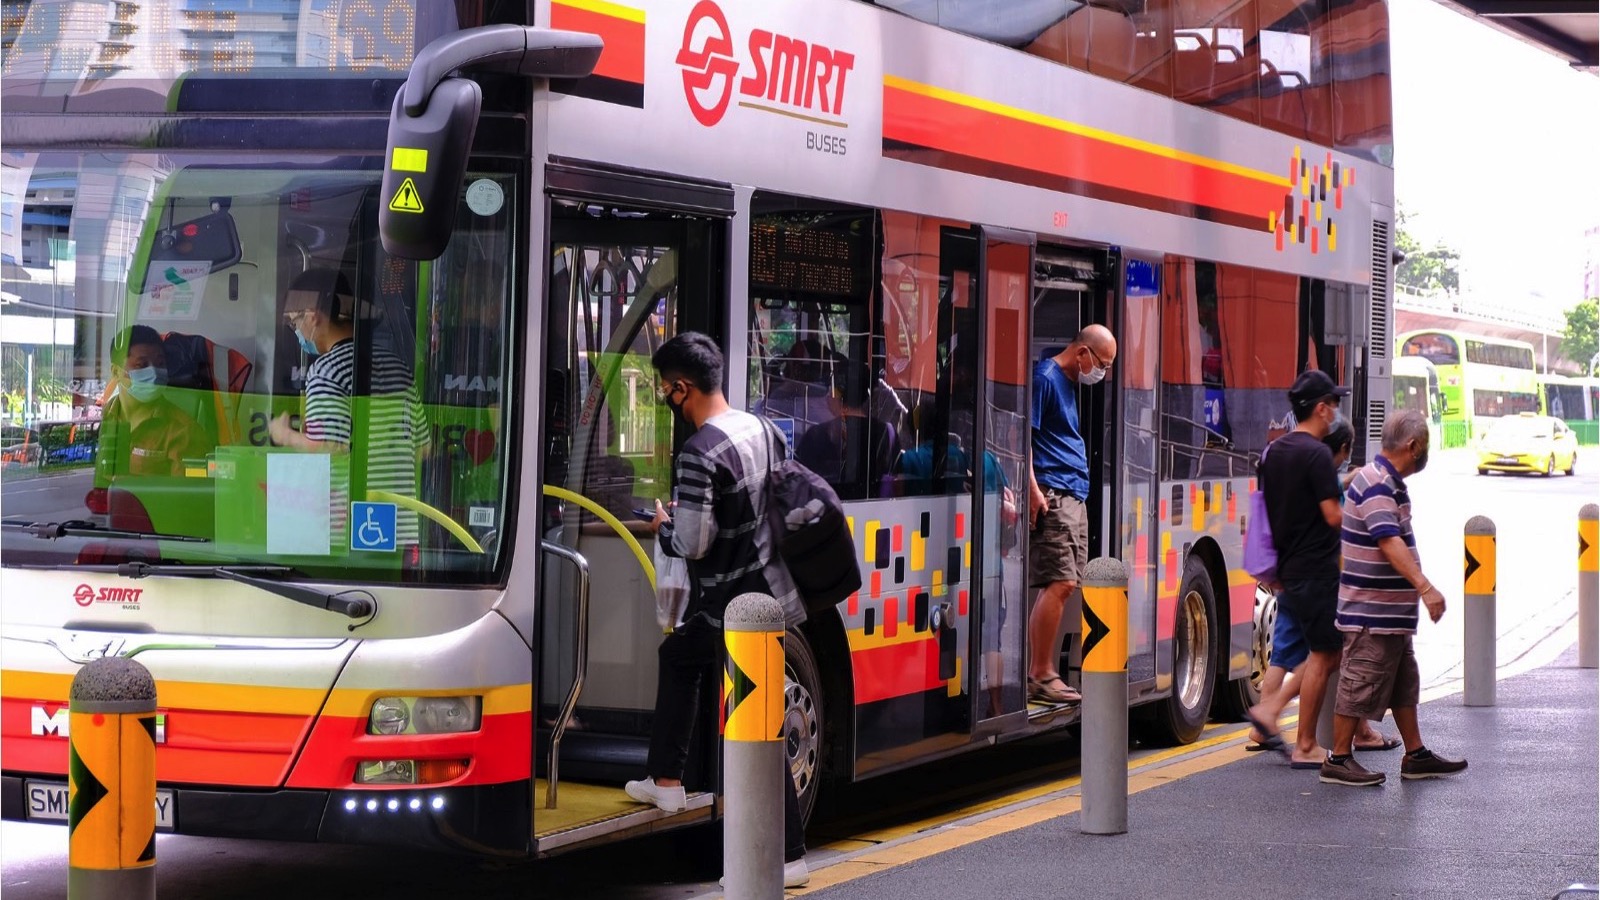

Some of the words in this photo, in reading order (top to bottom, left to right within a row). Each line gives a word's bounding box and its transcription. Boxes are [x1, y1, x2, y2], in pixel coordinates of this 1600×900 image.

[322, 0, 413, 72] 169
[740, 28, 855, 116] SMRT
[806, 131, 847, 156] BUSES
[1053, 210, 1068, 228] EXIT
[96, 587, 143, 602] SMRT
